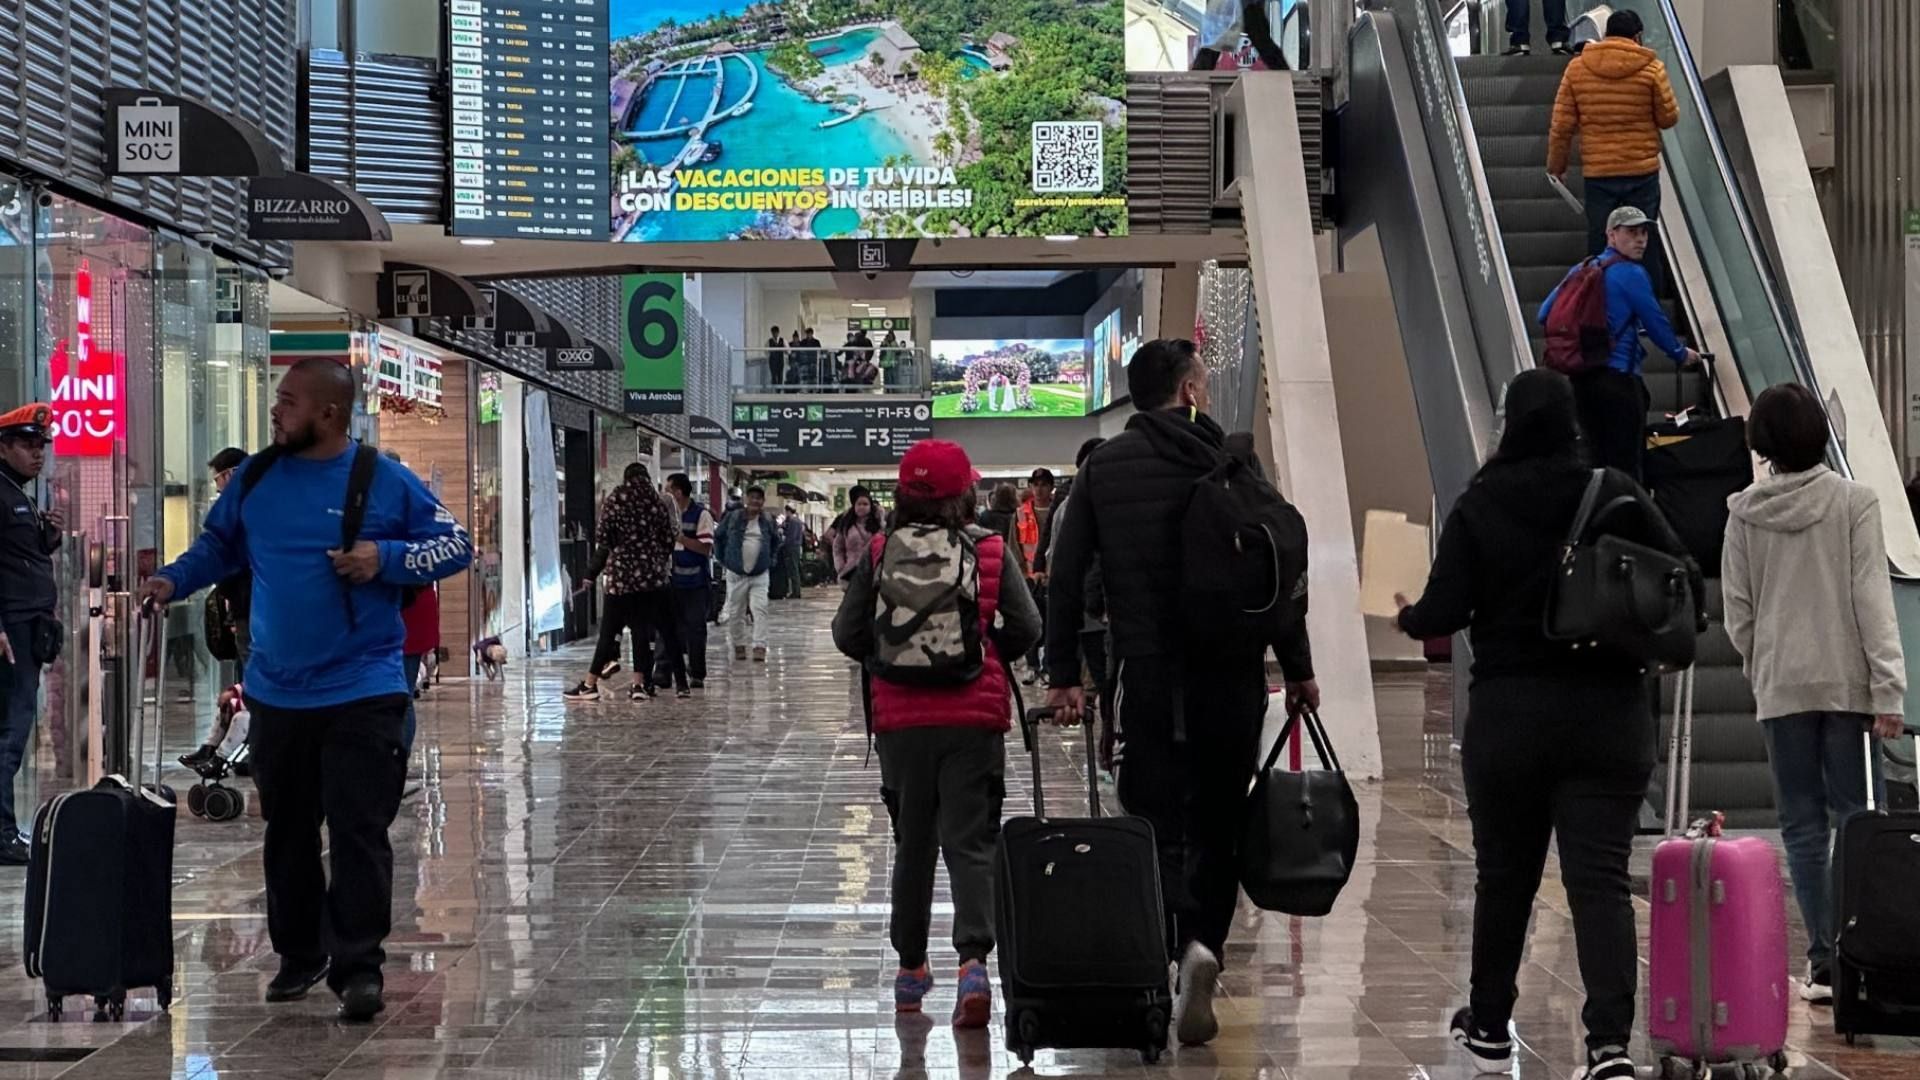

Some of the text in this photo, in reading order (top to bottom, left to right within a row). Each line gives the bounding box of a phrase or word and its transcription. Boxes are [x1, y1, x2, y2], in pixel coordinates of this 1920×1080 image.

[125, 121, 173, 138] MINI
[620, 167, 957, 192] ¡LAS VACACIONES DE TU VIDA
[254, 199, 350, 214] BIZZARRO
[620, 185, 972, 212] CON DESCUENTOS INCREÍBLES!
[397, 276, 426, 315] 7
[628, 281, 678, 359] 6
[558, 350, 593, 362] OXXO
[51, 374, 114, 401] MINI
[630, 392, 682, 400] Viva Aerobus
[783, 408, 805, 419] G-J
[877, 408, 911, 418] F1-F3
[798, 428, 823, 447] F2
[865, 428, 890, 447] F3
